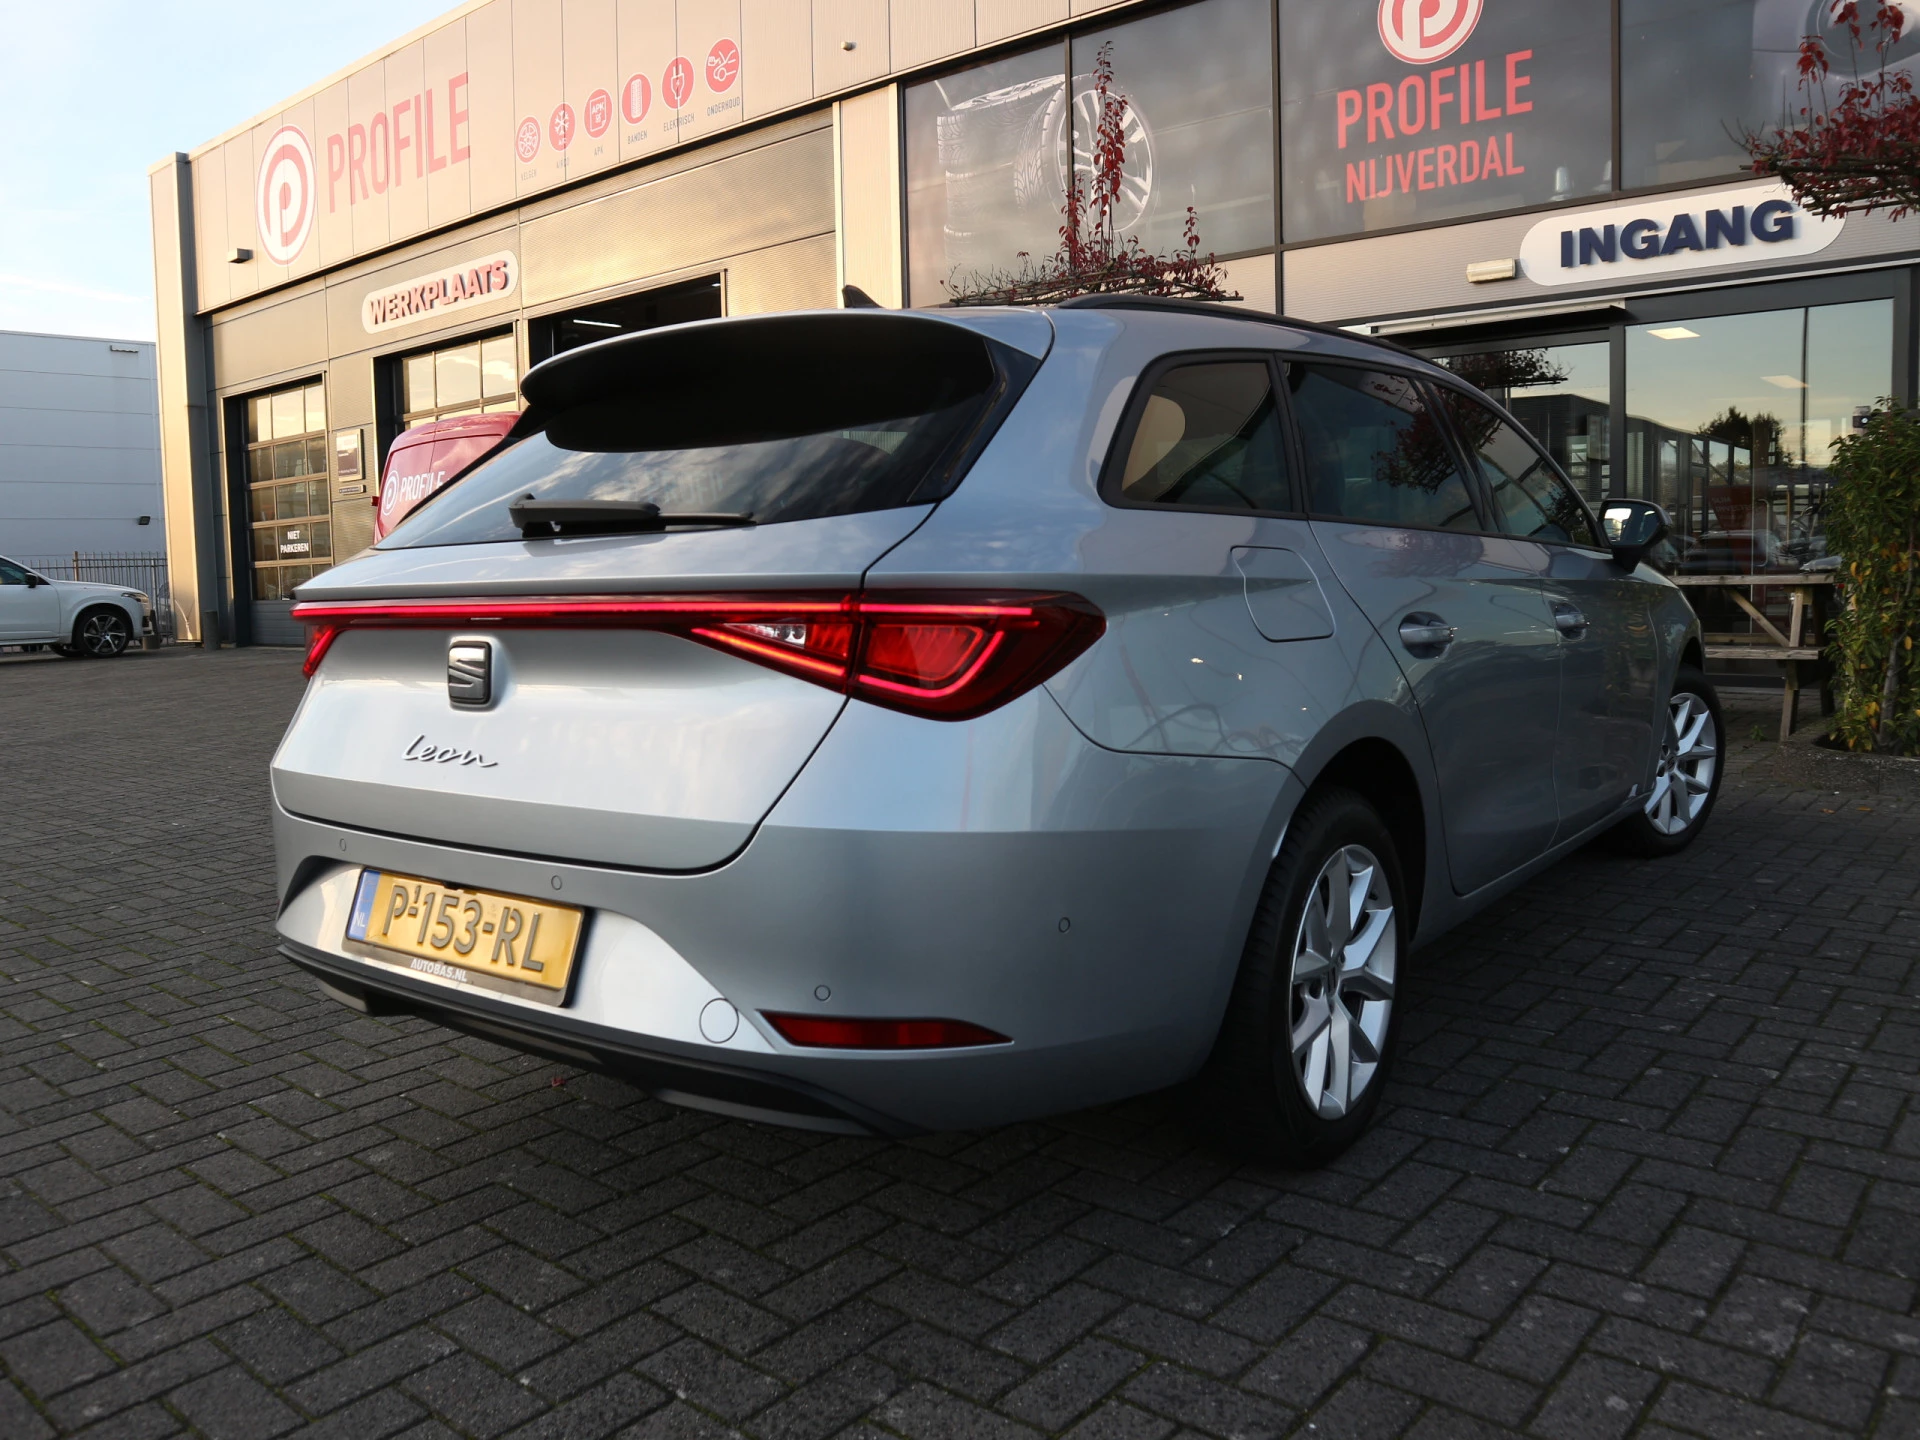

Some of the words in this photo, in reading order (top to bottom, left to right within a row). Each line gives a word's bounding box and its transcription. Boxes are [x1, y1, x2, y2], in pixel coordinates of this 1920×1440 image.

[706, 96, 741, 117] ONDERHOUD
[1337, 49, 1533, 149] PROFILE
[663, 113, 695, 132] ELEKTRISCH
[327, 72, 471, 213] PROFILE
[627, 130, 648, 145] BANDEN
[593, 147, 604, 157] APK
[1346, 133, 1525, 204] NIJVERDAL
[1560, 200, 1795, 268] INGANG
[369, 260, 508, 325] WERKPLAATS
[287, 530, 300, 540] NIET
[280, 543, 309, 553] PARKEREN
[353, 912, 367, 929] NL
[410, 957, 468, 983] AUTOBAS.NL
